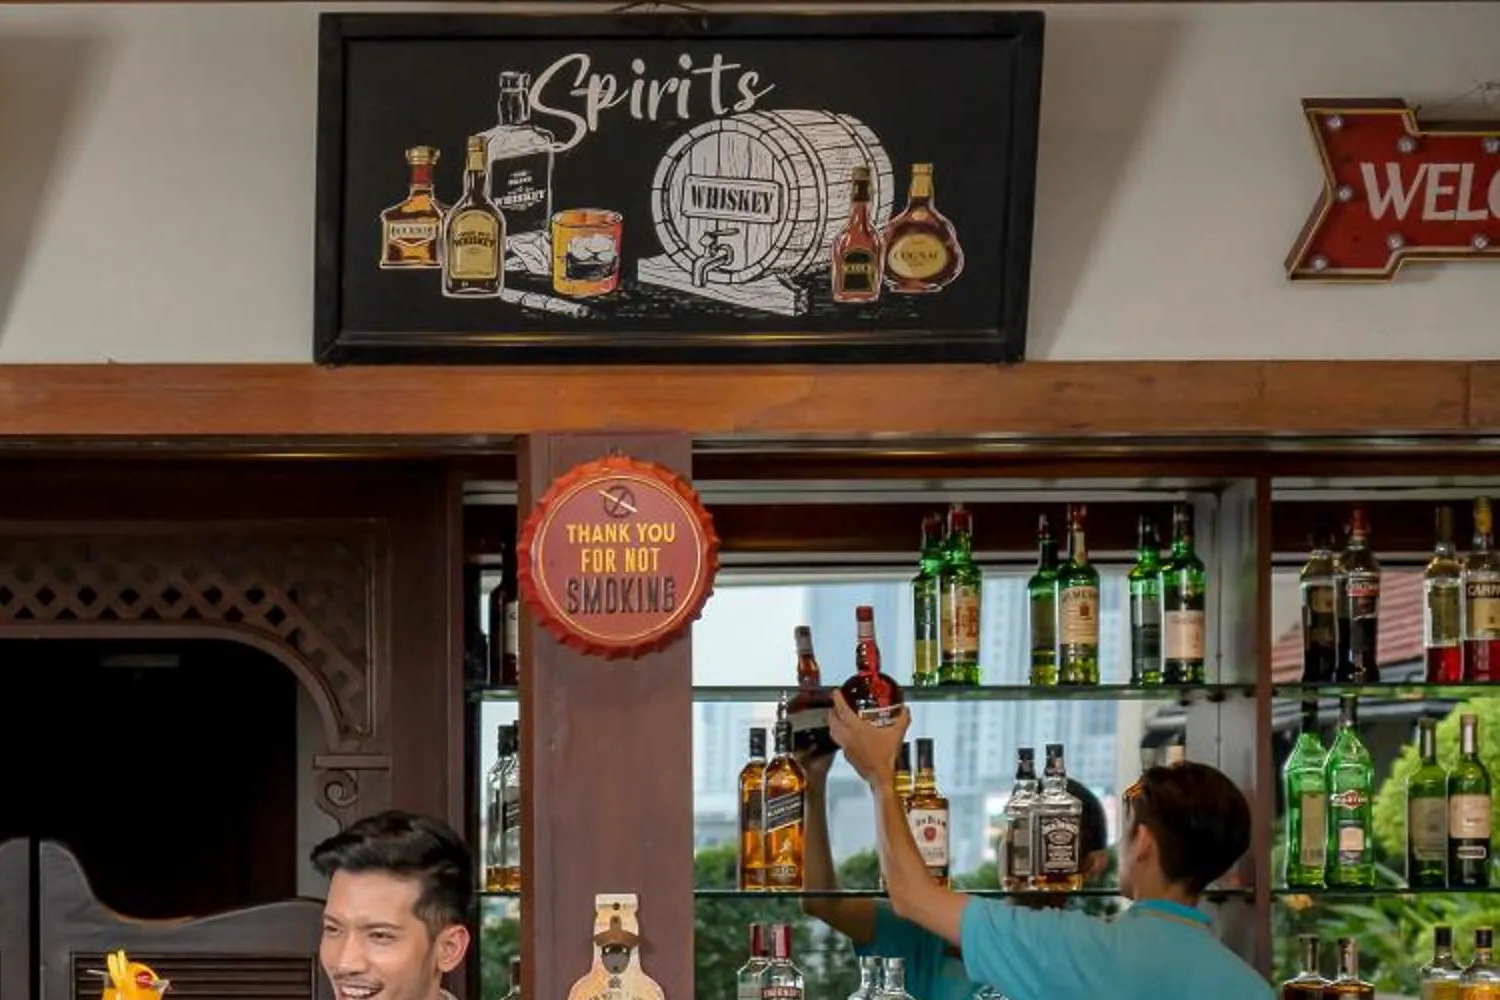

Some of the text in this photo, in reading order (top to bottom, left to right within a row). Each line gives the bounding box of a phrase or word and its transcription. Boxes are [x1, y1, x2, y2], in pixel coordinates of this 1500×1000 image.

[529, 53, 776, 152] Spirits
[690, 185, 774, 214] WHISKEY
[566, 523, 676, 544] THANK YOU
[581, 547, 661, 573] FOR NOT
[567, 577, 677, 615] SMOKING
